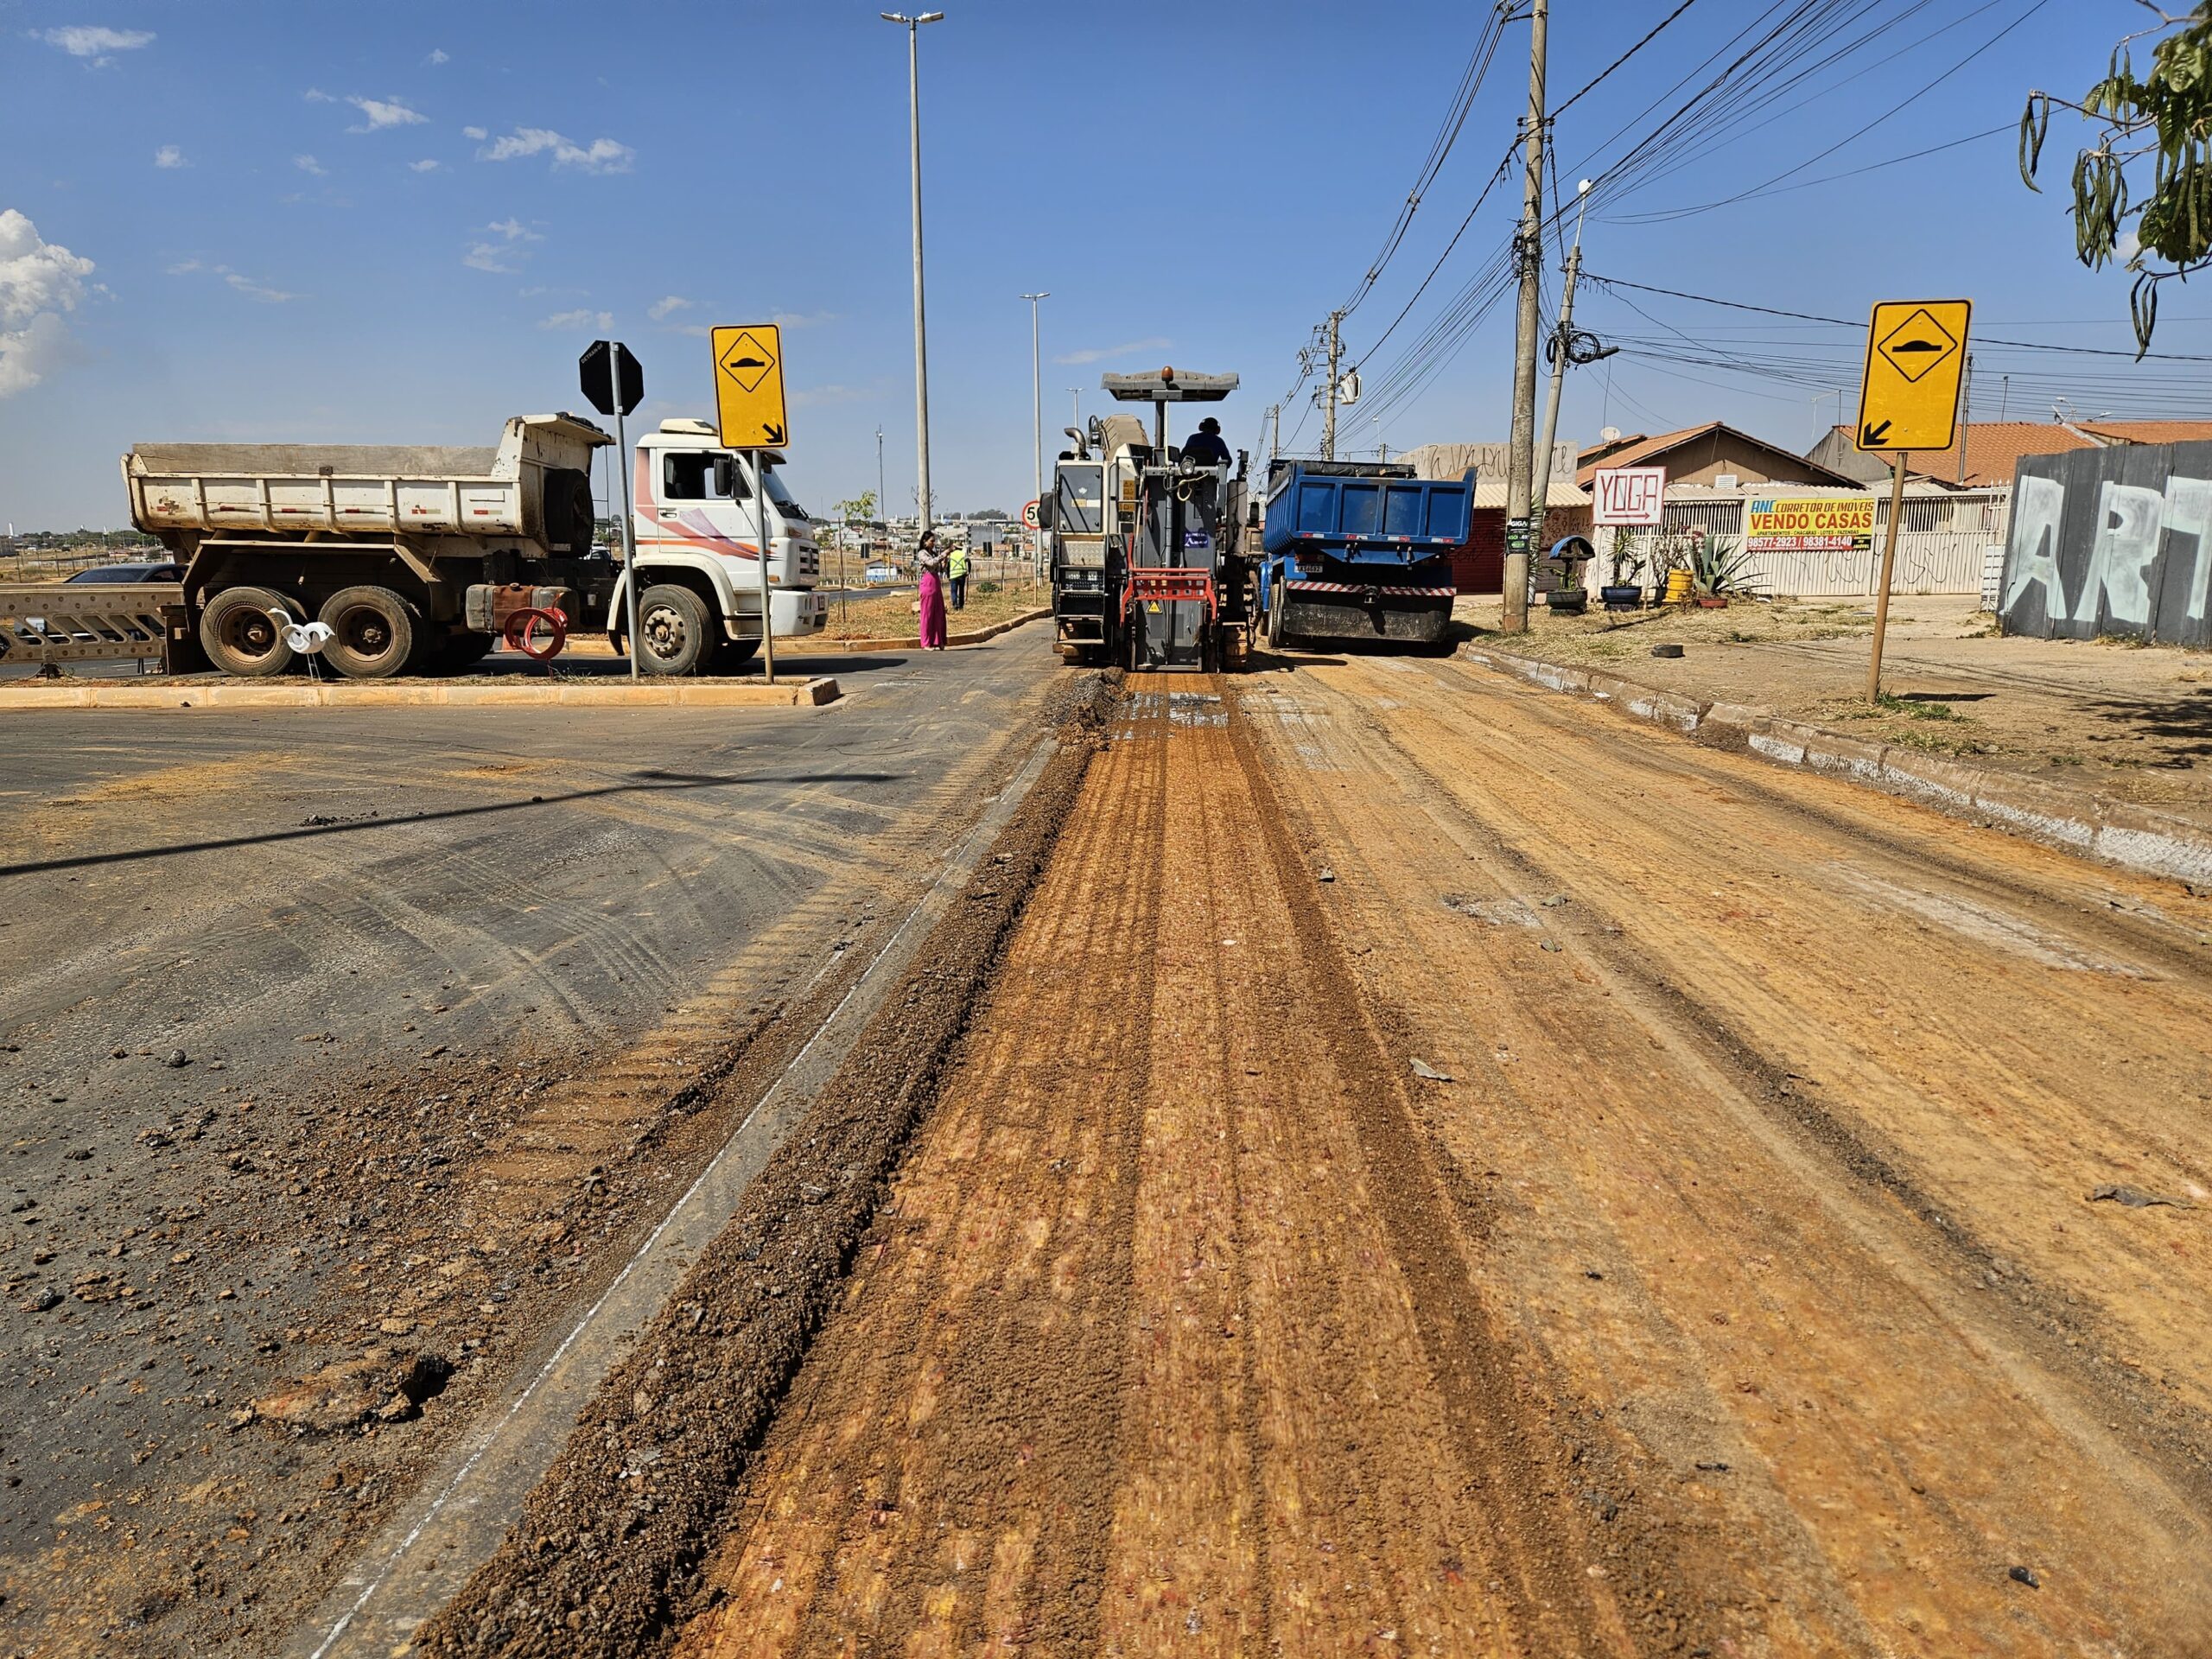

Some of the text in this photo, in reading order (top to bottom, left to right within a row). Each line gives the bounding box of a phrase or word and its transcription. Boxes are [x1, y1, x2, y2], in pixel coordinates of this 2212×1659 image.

[1601, 474, 1658, 512] YOGA
[1776, 503, 1823, 513] CORRETOR
[1824, 502, 1836, 512] DE
[1751, 512, 1872, 530] VENDO CASAS
[1748, 537, 1796, 548] 98577-2923
[1803, 536, 1853, 547] 98381-4140
